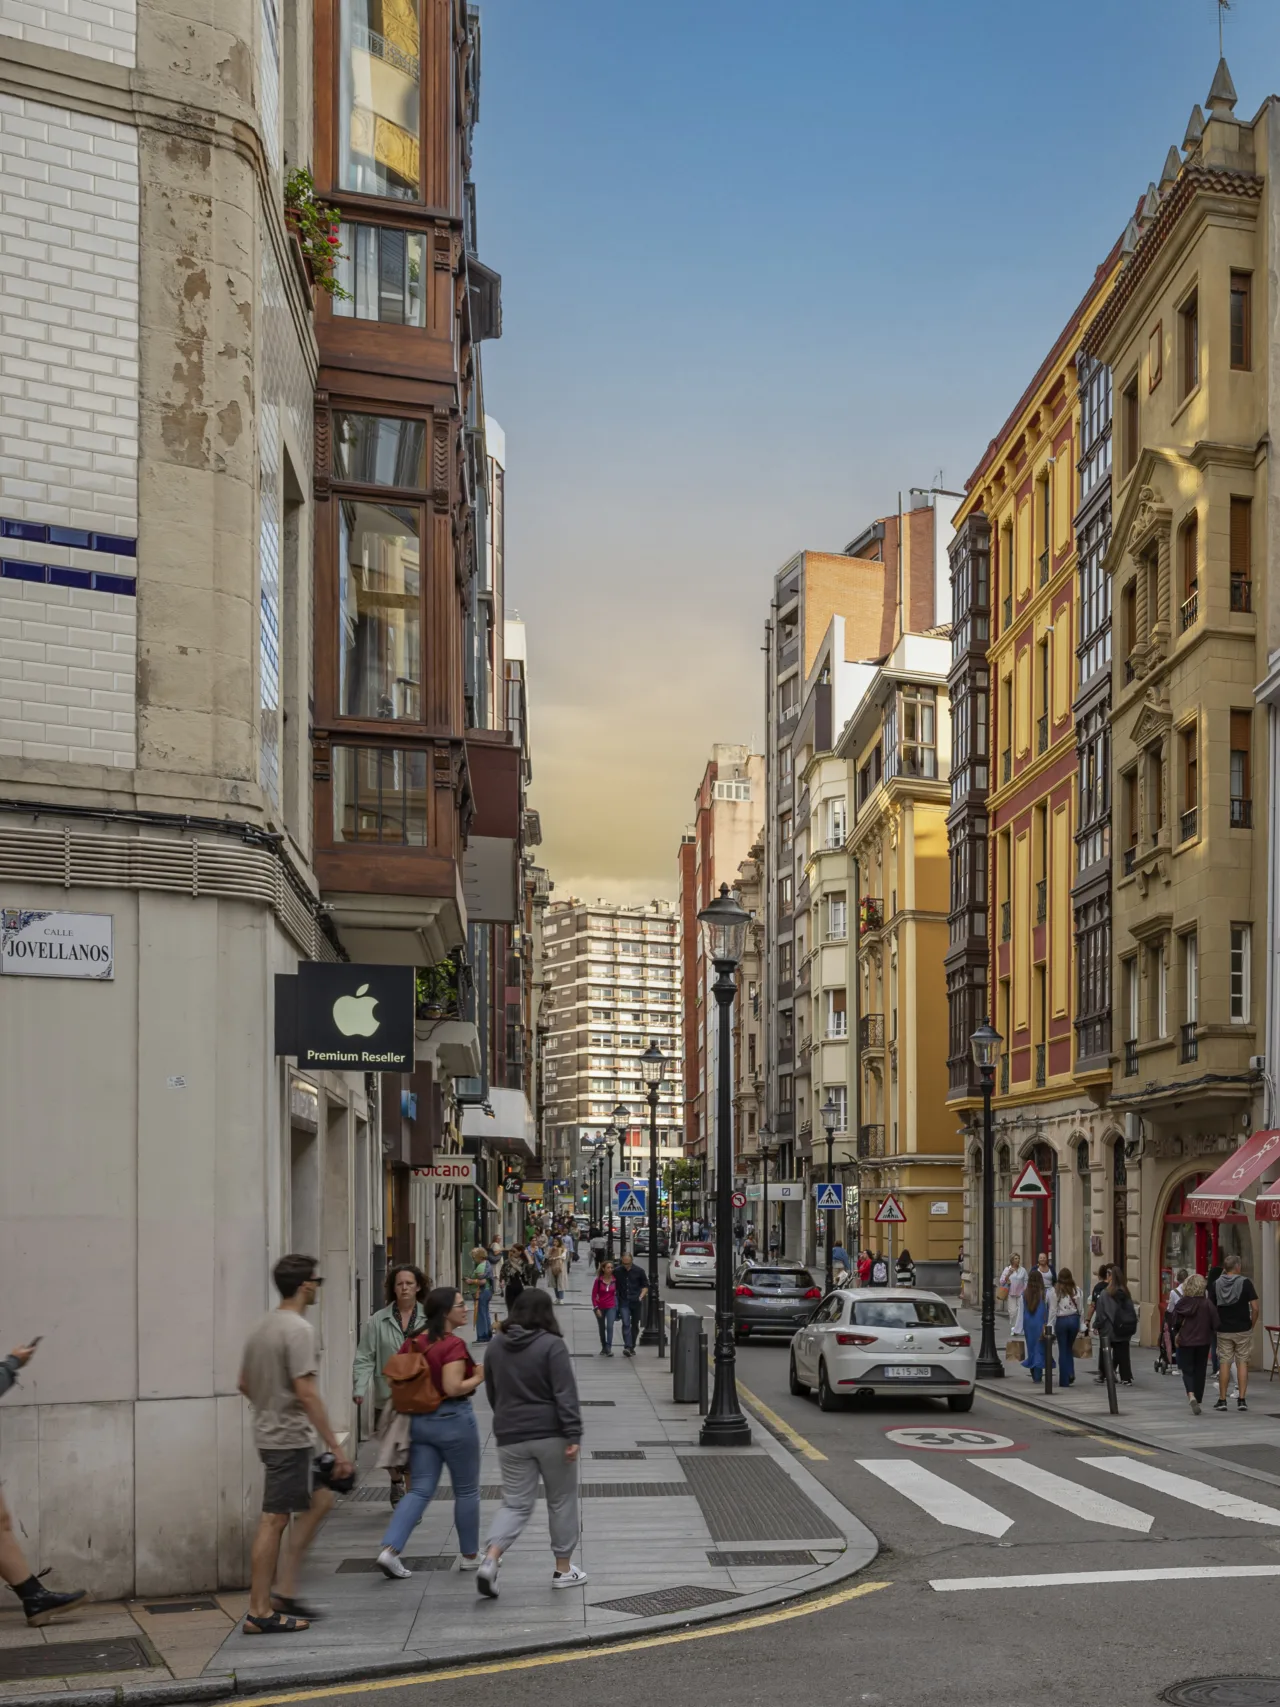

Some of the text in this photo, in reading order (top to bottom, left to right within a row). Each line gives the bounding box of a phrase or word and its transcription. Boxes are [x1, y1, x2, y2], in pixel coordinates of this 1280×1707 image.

[43, 928, 74, 937] CALLE
[7, 940, 109, 962] JOVELLANOS
[307, 1050, 406, 1063] Premium Reseller
[890, 1366, 929, 1377] 1415 JNB
[901, 1432, 997, 1445] 30
